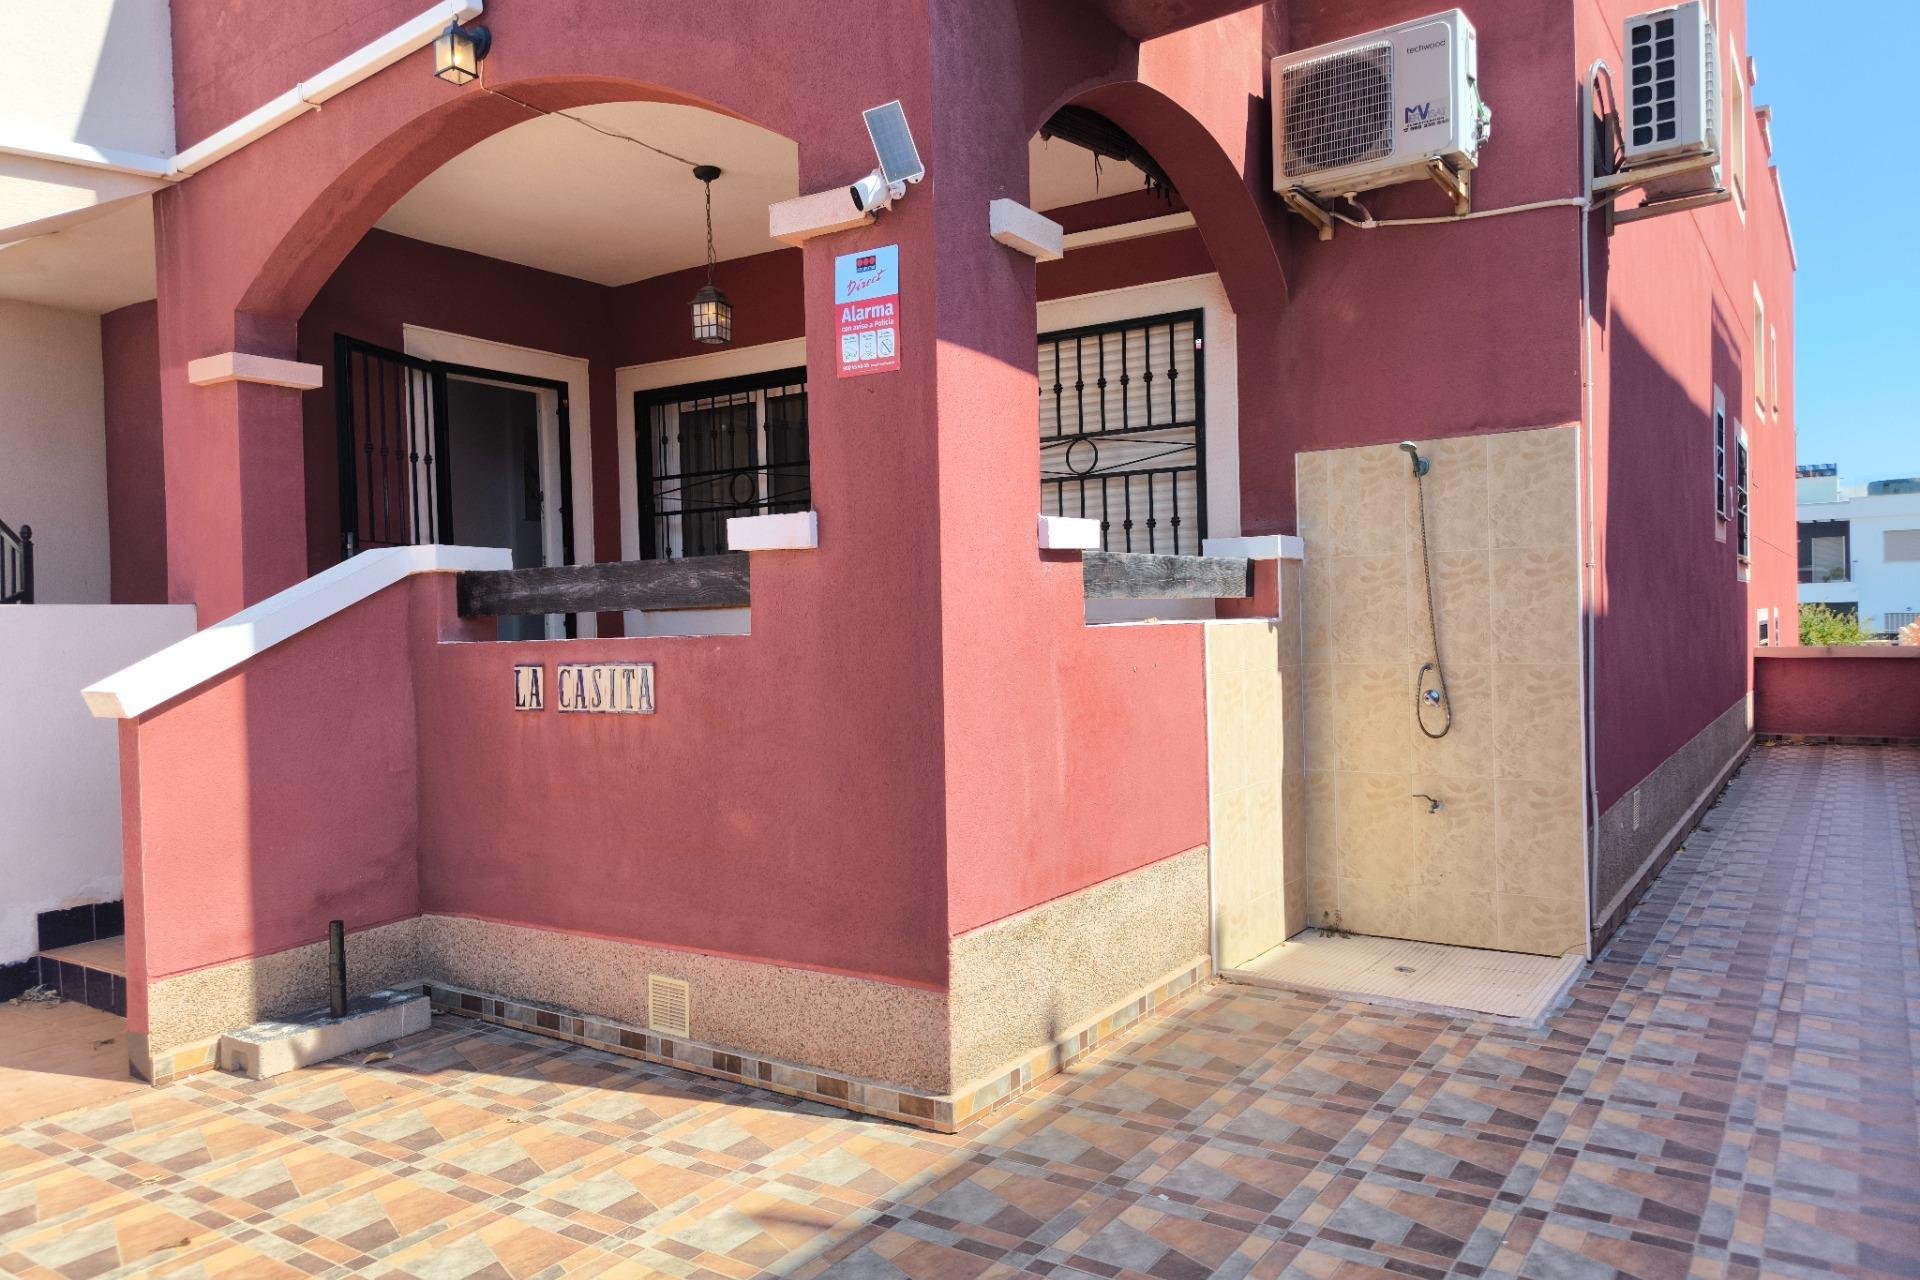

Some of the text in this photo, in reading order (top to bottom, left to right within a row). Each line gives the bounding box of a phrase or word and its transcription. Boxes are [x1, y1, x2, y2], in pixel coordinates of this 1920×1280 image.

[1406, 40, 1446, 54] techwood
[847, 268, 886, 296] Direct
[841, 302, 894, 323] Alarma
[515, 667, 653, 710] LA CASITA
